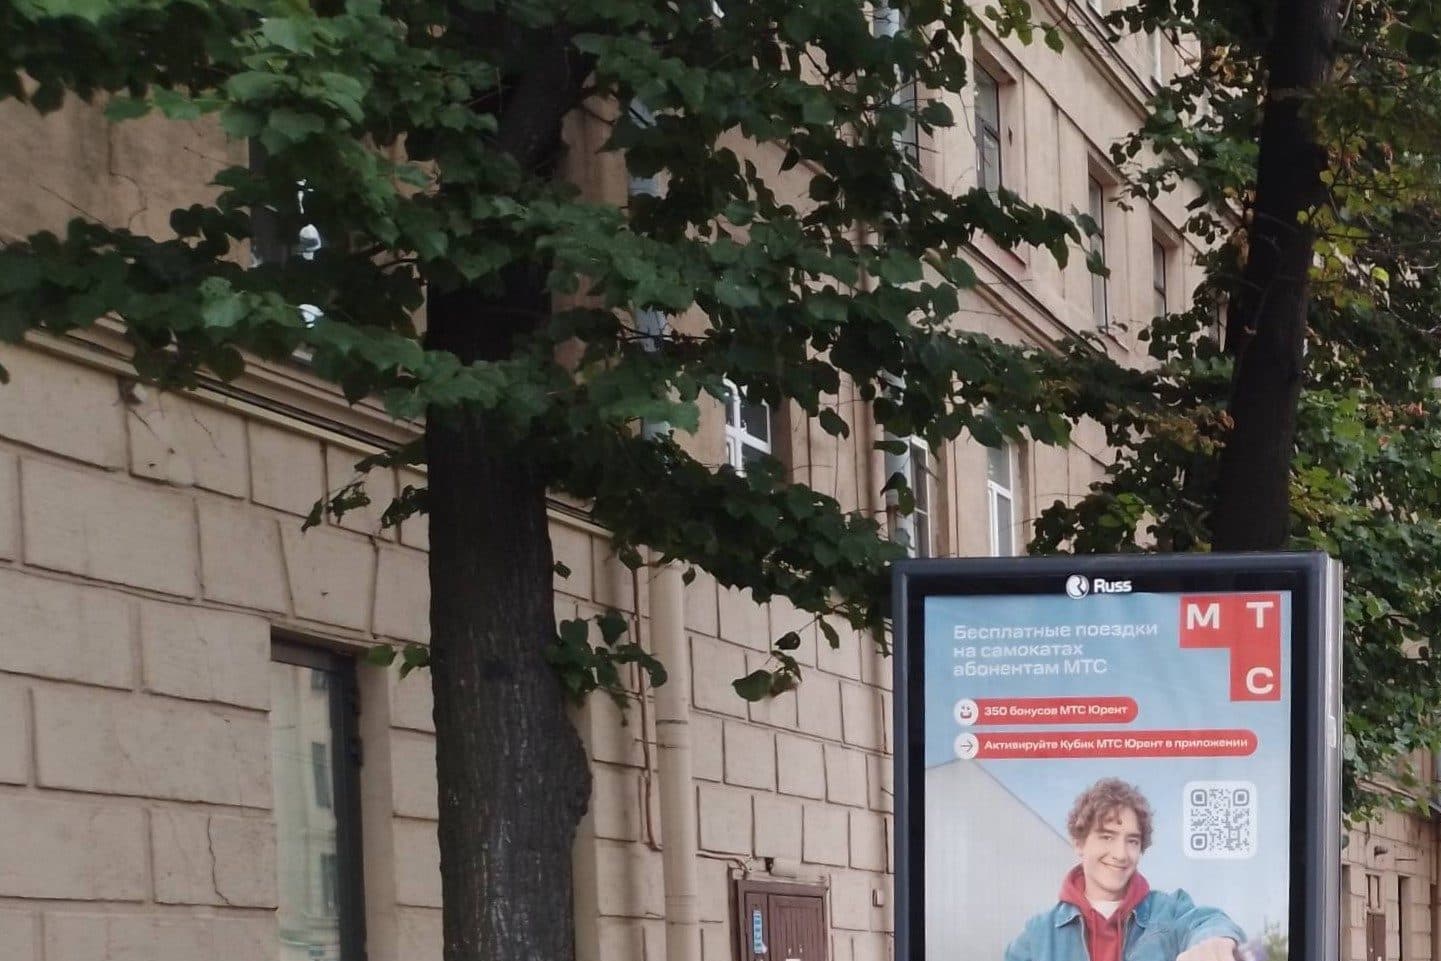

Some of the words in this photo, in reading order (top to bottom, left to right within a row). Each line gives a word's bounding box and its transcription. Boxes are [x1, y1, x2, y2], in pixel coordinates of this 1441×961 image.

[1093, 578, 1133, 594] Russ
[953, 624, 1072, 640] Бесплатные
[1075, 623, 1159, 639] поездки
[953, 645, 977, 658] на
[980, 642, 1084, 658] самокатах
[953, 660, 1060, 677] абонентам
[1063, 657, 1108, 675] МТС
[984, 705, 1008, 716] 350
[1009, 705, 1058, 718] бонусов
[1060, 704, 1087, 715] МТС
[1088, 704, 1128, 716] Юрент
[984, 739, 1058, 751] Активируйте
[1060, 738, 1095, 751] Кубик
[1096, 738, 1123, 749] МТС
[1124, 738, 1164, 750] Юрент
[1165, 739, 1173, 748] в
[1174, 738, 1249, 750] приложении
